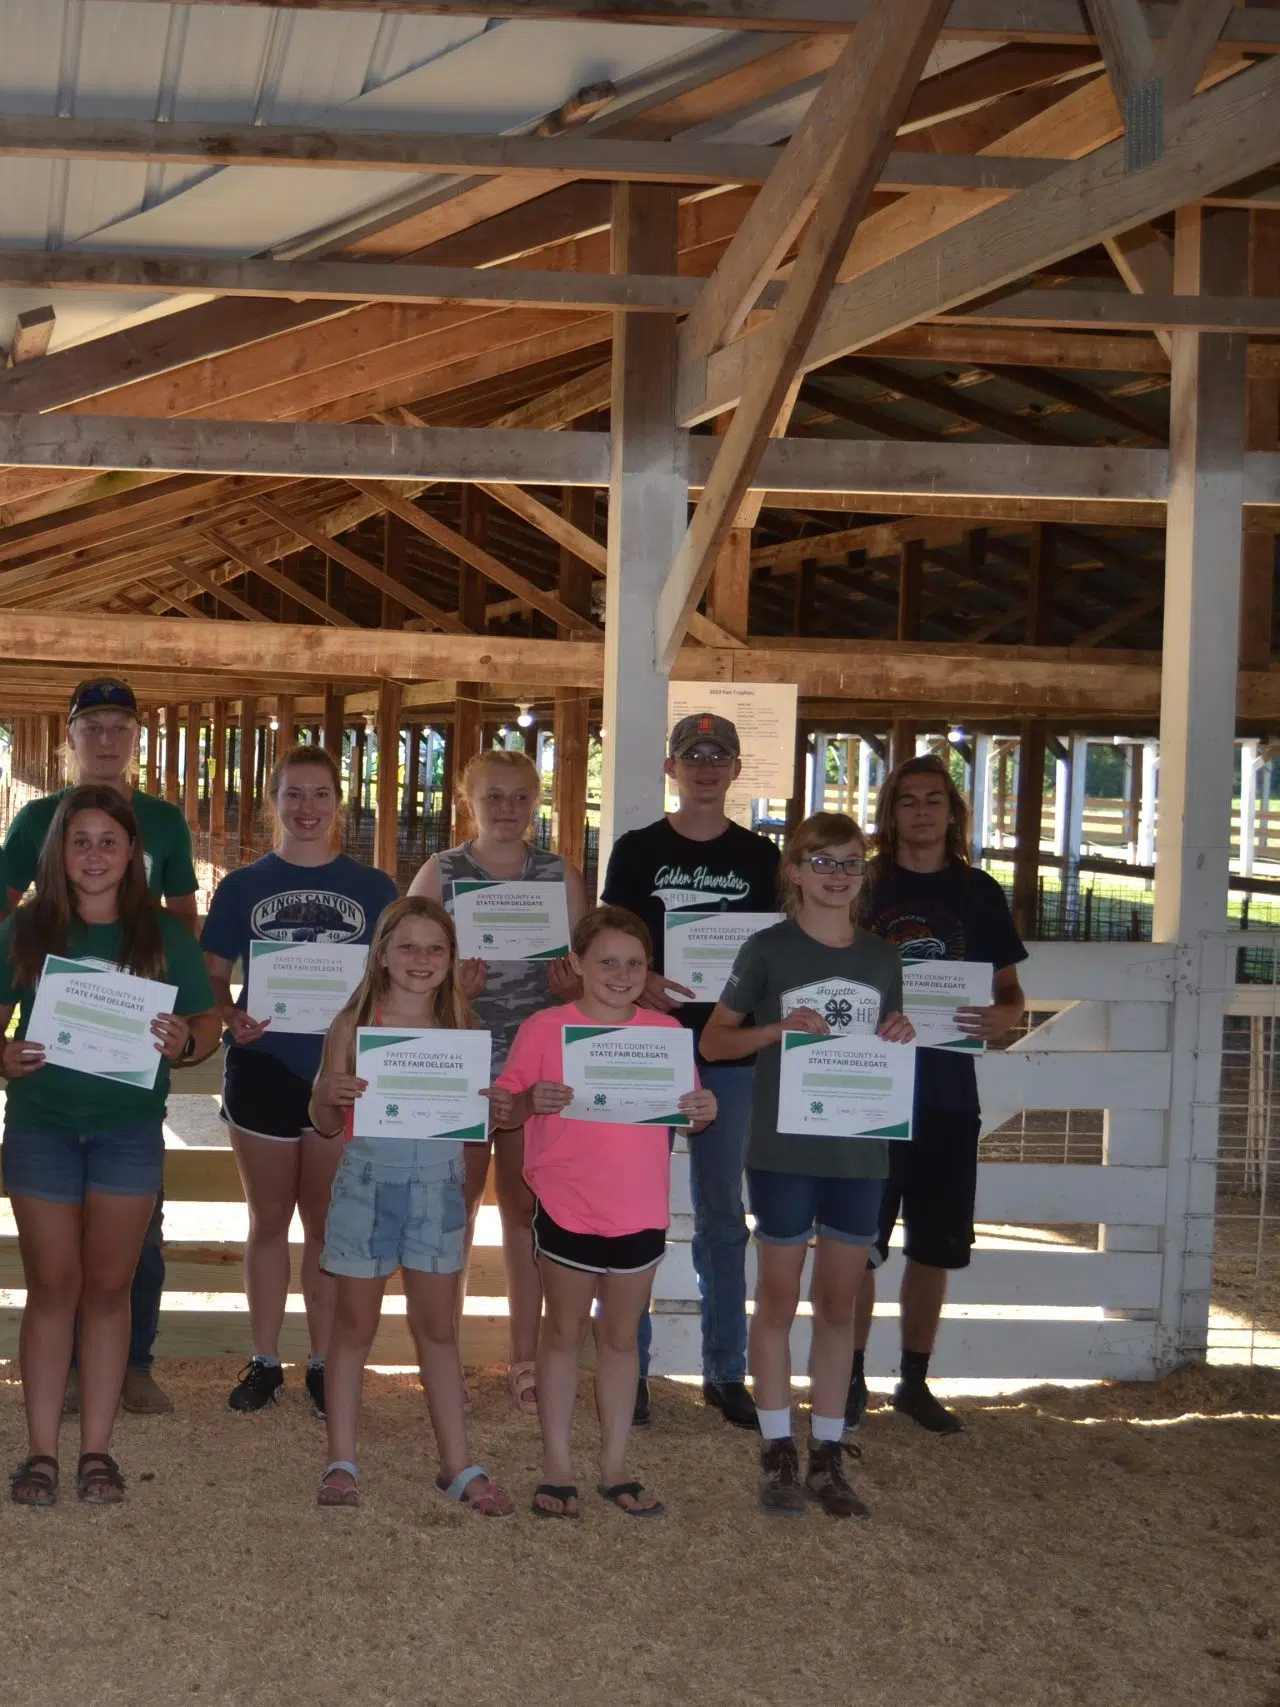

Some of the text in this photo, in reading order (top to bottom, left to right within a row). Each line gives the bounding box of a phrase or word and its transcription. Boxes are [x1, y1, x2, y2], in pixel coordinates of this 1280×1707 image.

[654, 866, 691, 888] Golden
[677, 893, 696, 902] CLUB
[261, 894, 356, 920] KINGS CANYON
[70, 979, 101, 993] FAYETTE
[102, 987, 131, 998] COUNTY
[816, 986, 858, 997] Fayette
[66, 987, 88, 998] STATE
[89, 993, 106, 1002] FAIR
[106, 997, 145, 1012] DELEGATE
[418, 1052, 448, 1060] COUNTY
[843, 1050, 872, 1058] COUNTY
[425, 1061, 464, 1069] DELEGATE
[850, 1060, 888, 1068] DELEGATE
